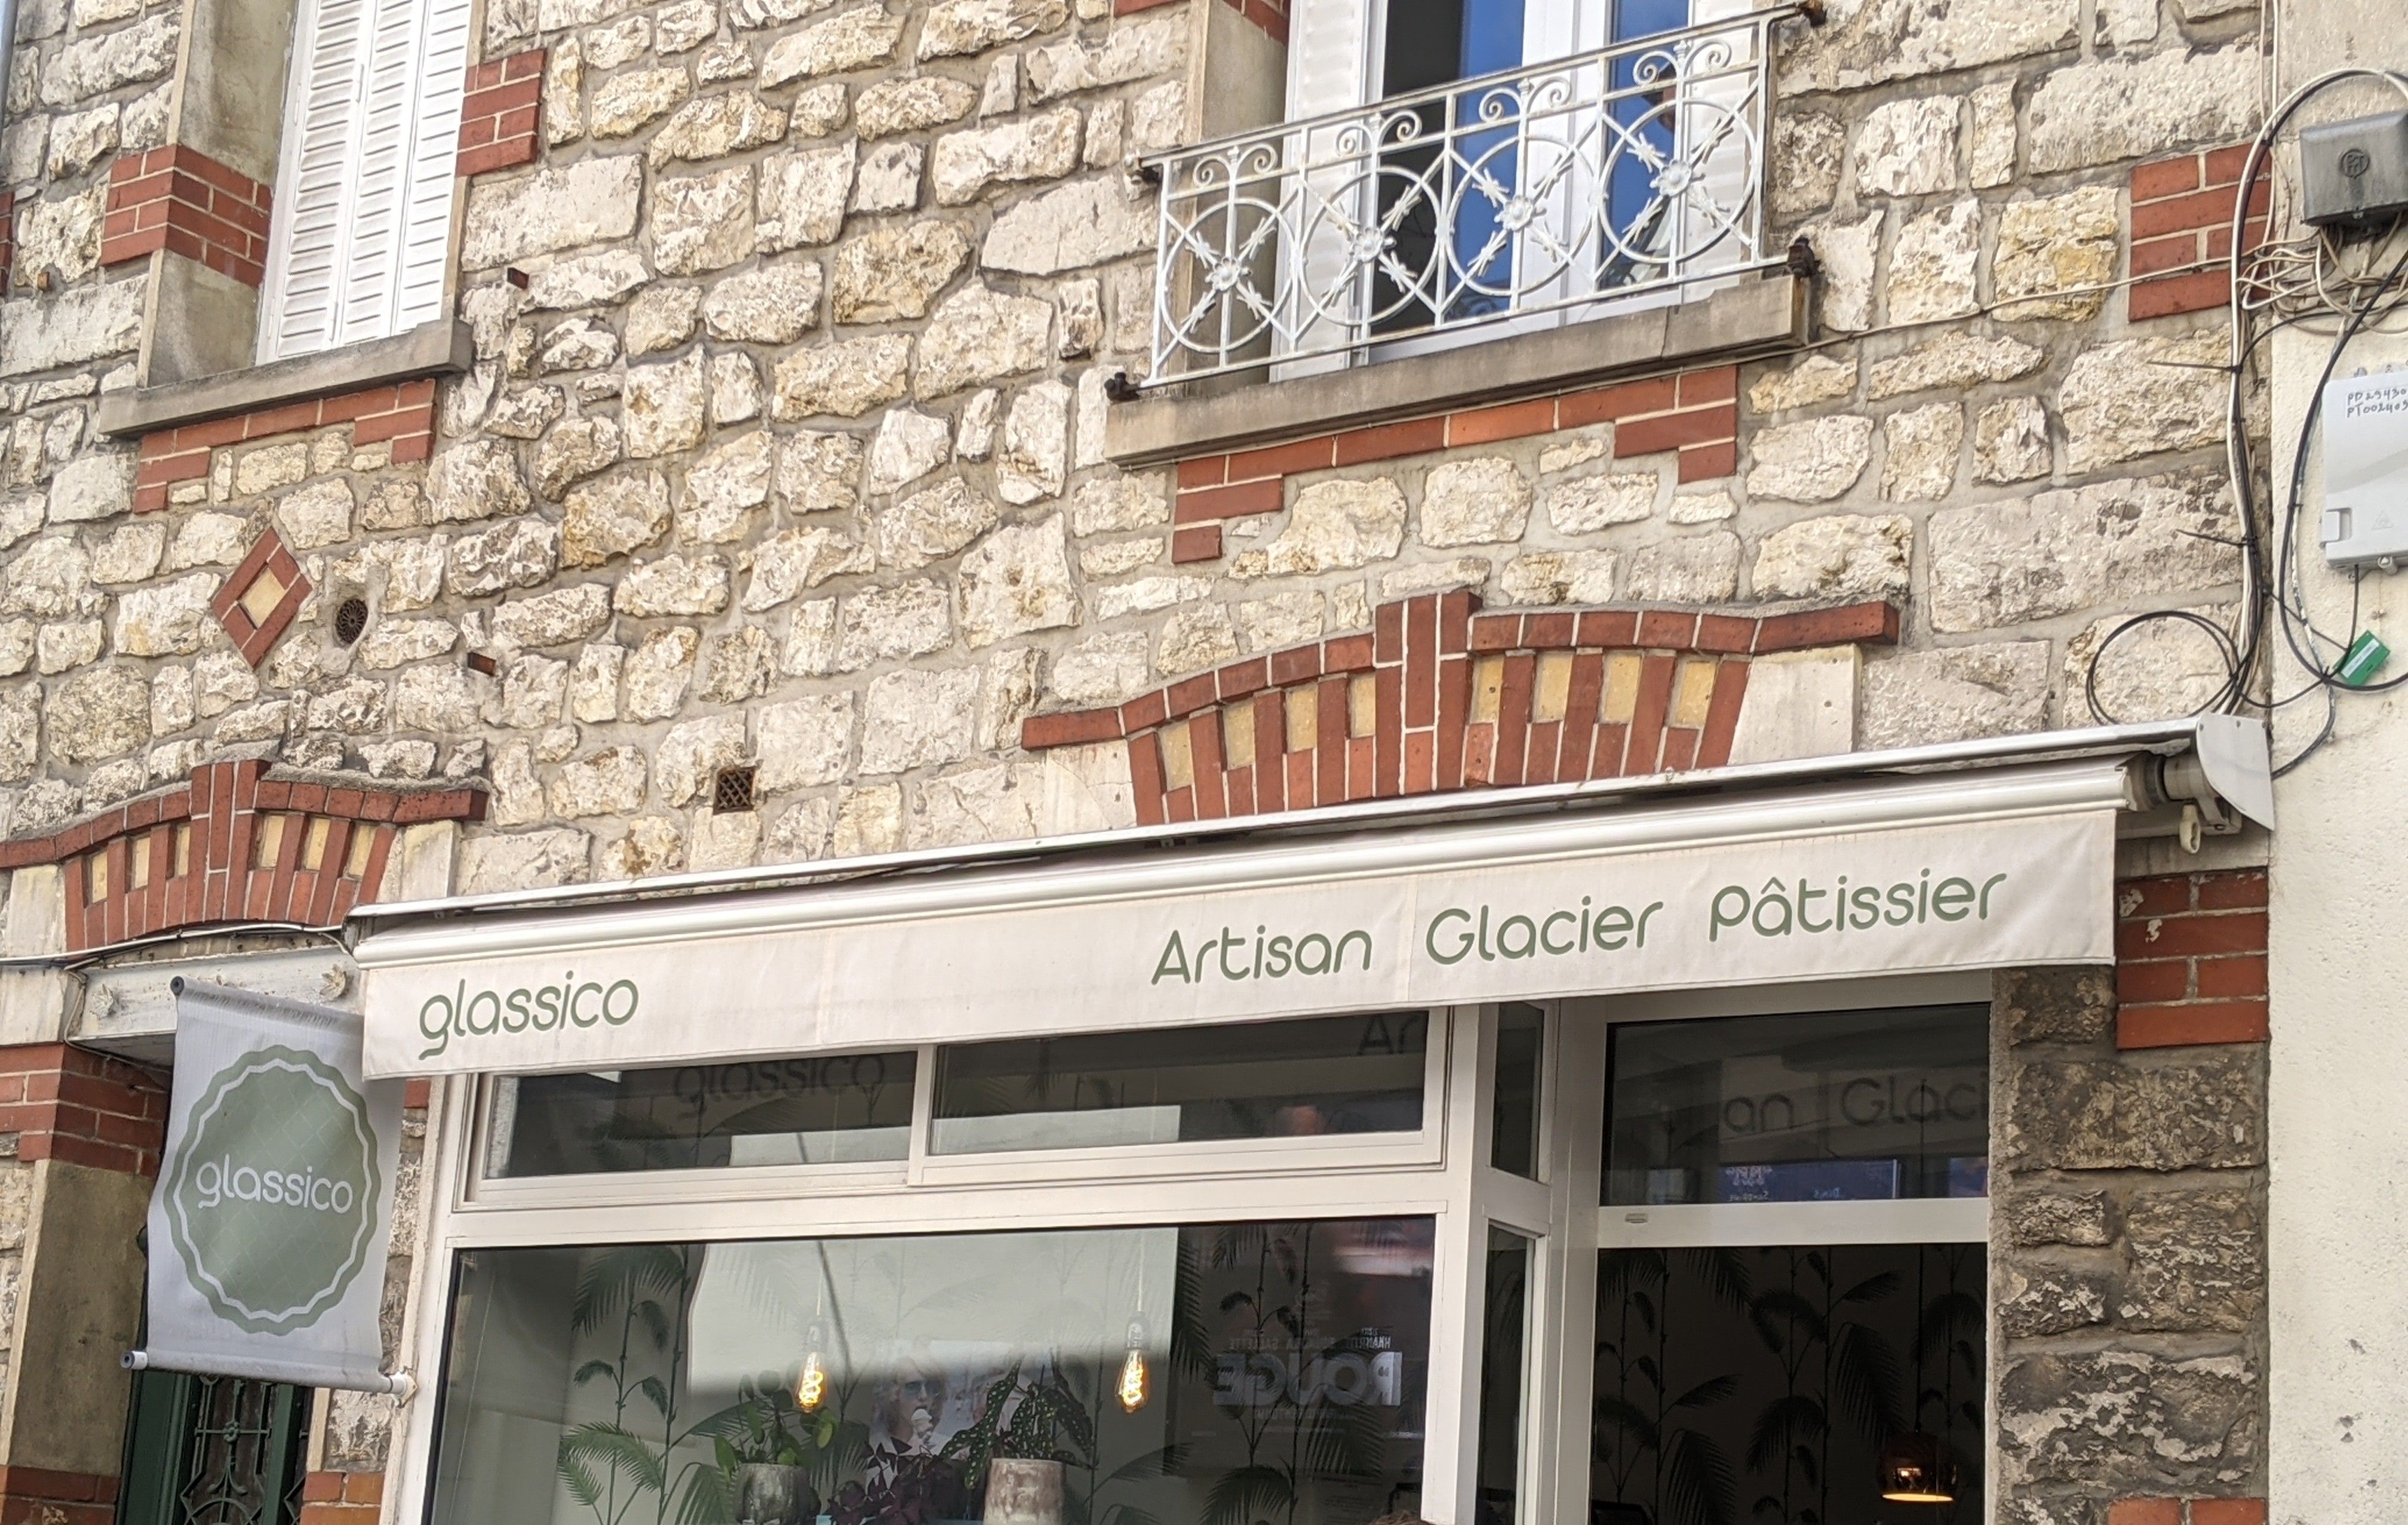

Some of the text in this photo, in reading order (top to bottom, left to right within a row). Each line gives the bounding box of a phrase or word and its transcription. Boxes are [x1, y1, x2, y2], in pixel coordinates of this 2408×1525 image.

[419, 970, 638, 1060] glassico
[1151, 924, 1372, 985] Artisan
[1426, 895, 1664, 965] Glacier
[196, 1154, 353, 1213] glassico
